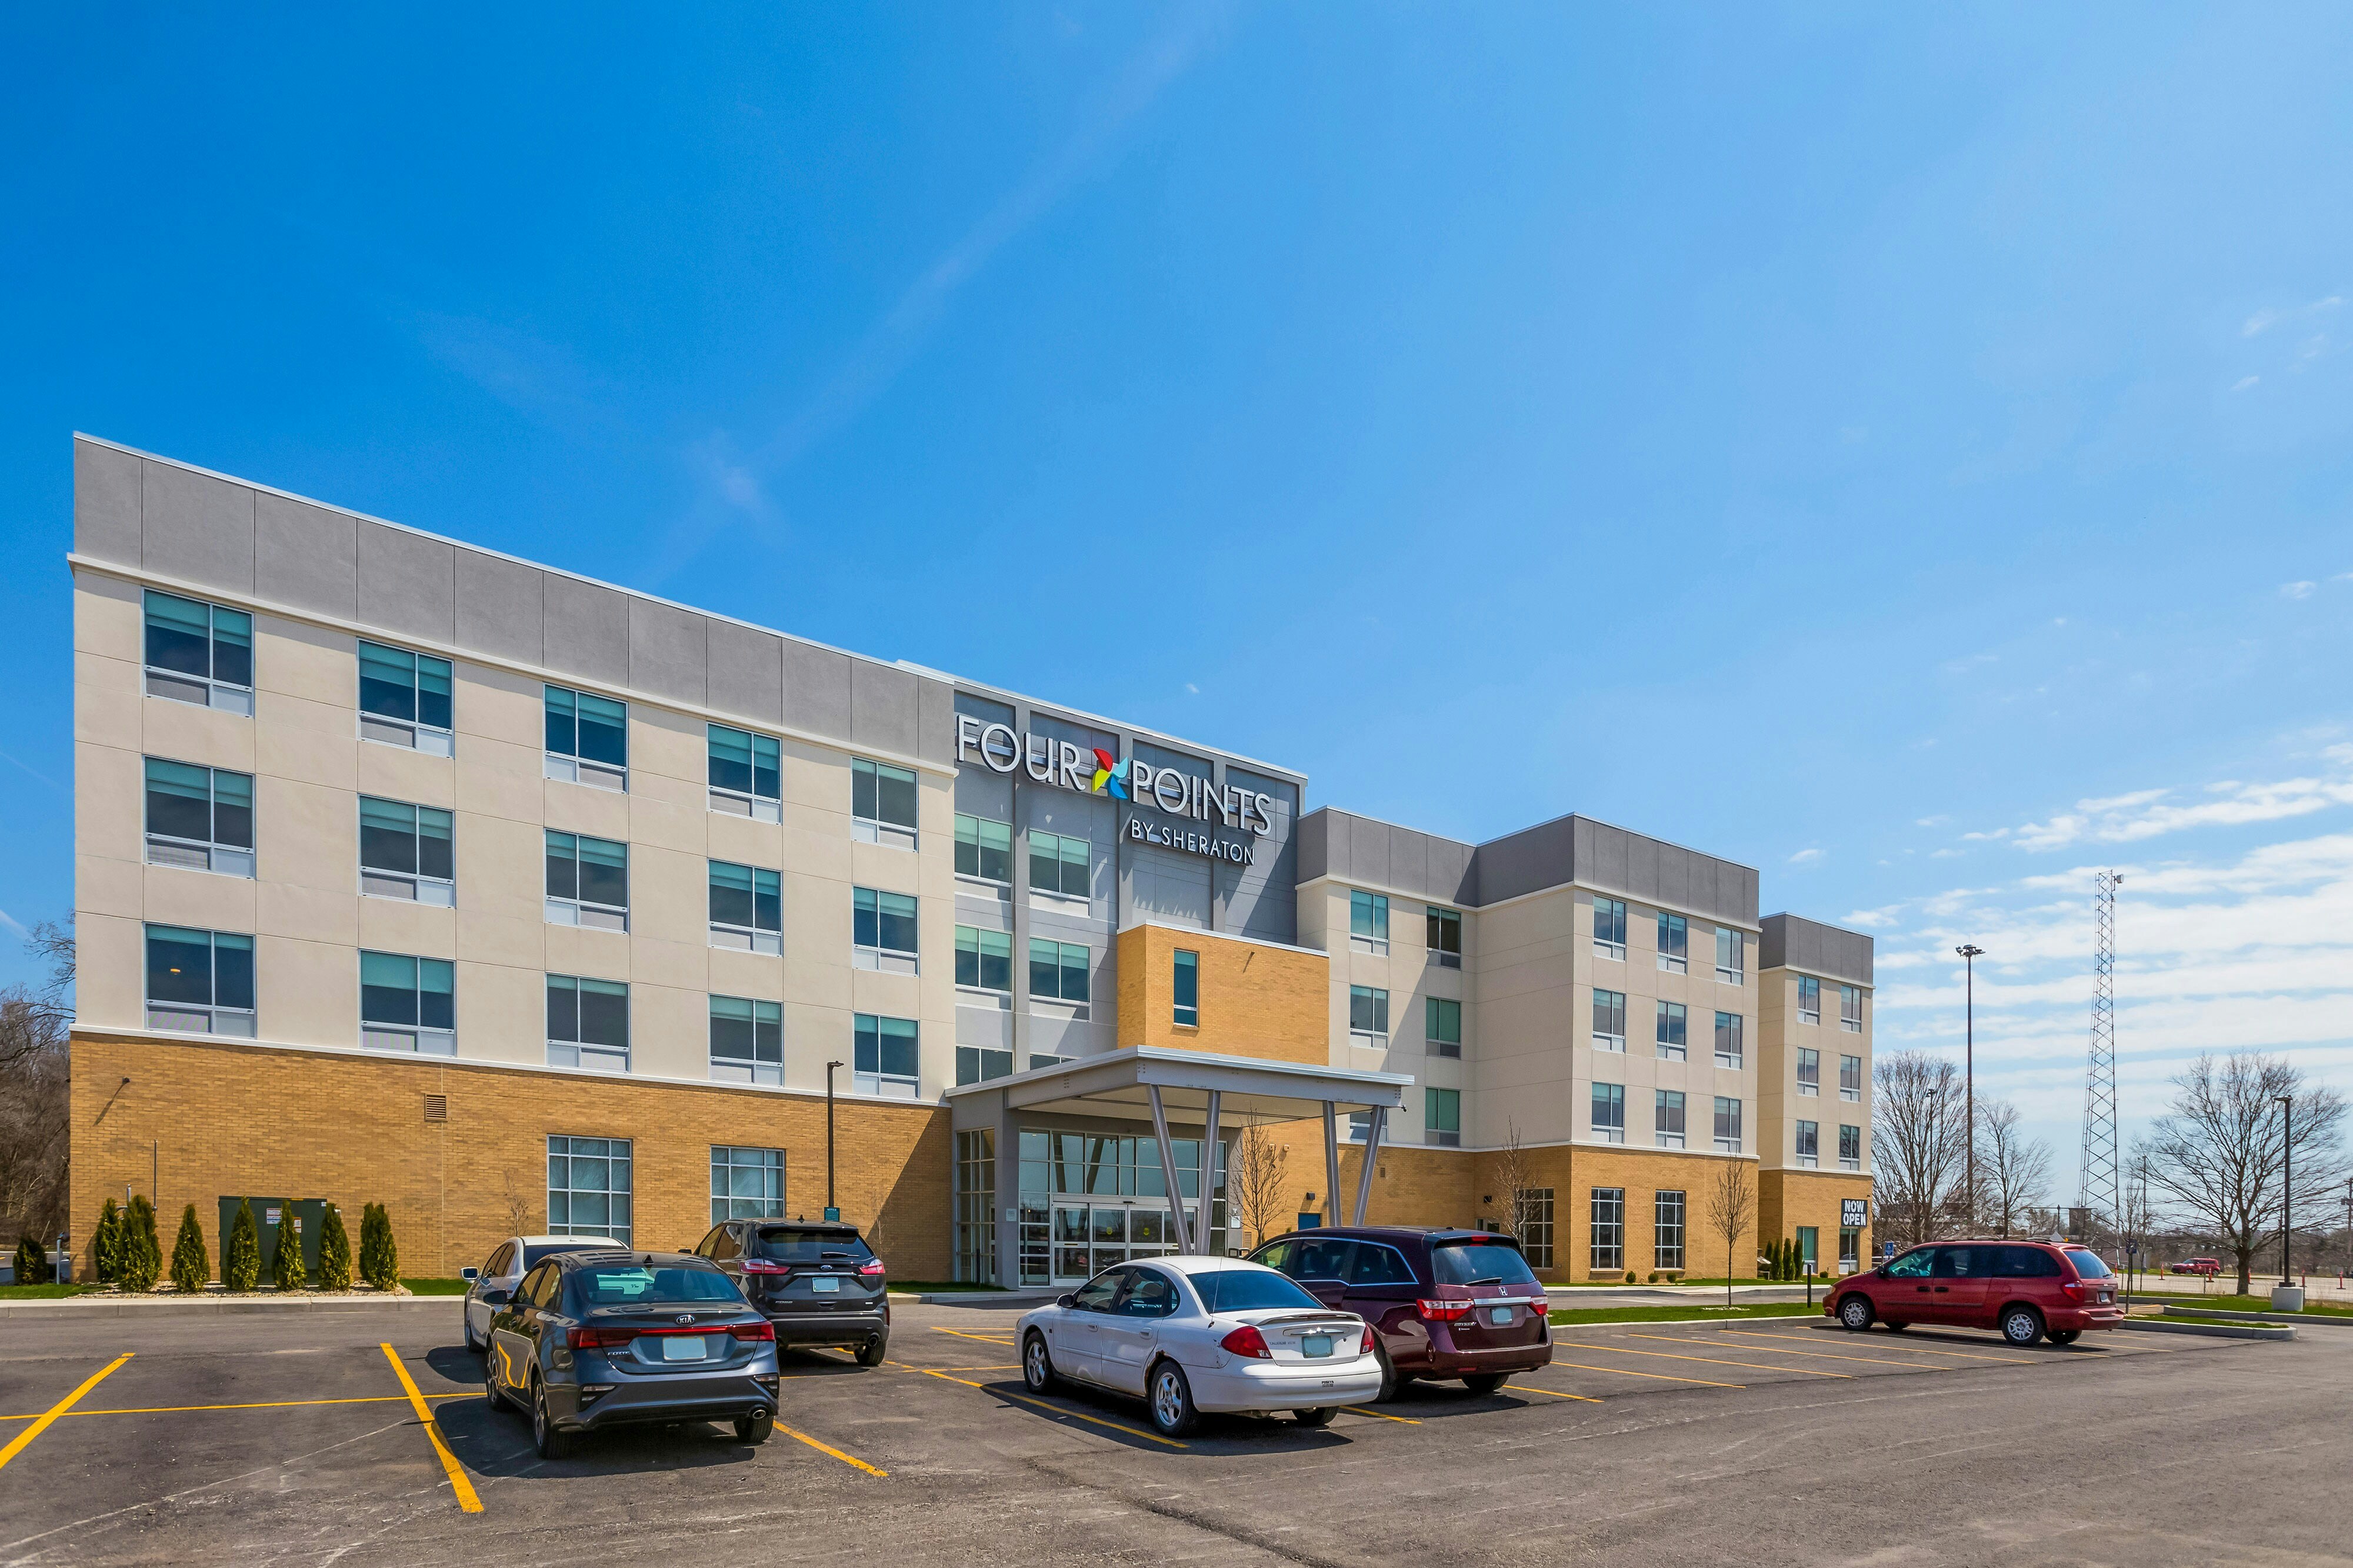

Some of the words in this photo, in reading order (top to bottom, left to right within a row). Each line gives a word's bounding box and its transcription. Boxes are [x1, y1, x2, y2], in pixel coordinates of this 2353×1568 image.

[955, 714, 1086, 792] FOUR
[1131, 759, 1271, 836] POINTS
[1131, 818, 1154, 840] BY
[1162, 826, 1255, 866] SHERATON
[1843, 1213, 1867, 1226] OPEN
[1844, 1200, 1864, 1213] NOW
